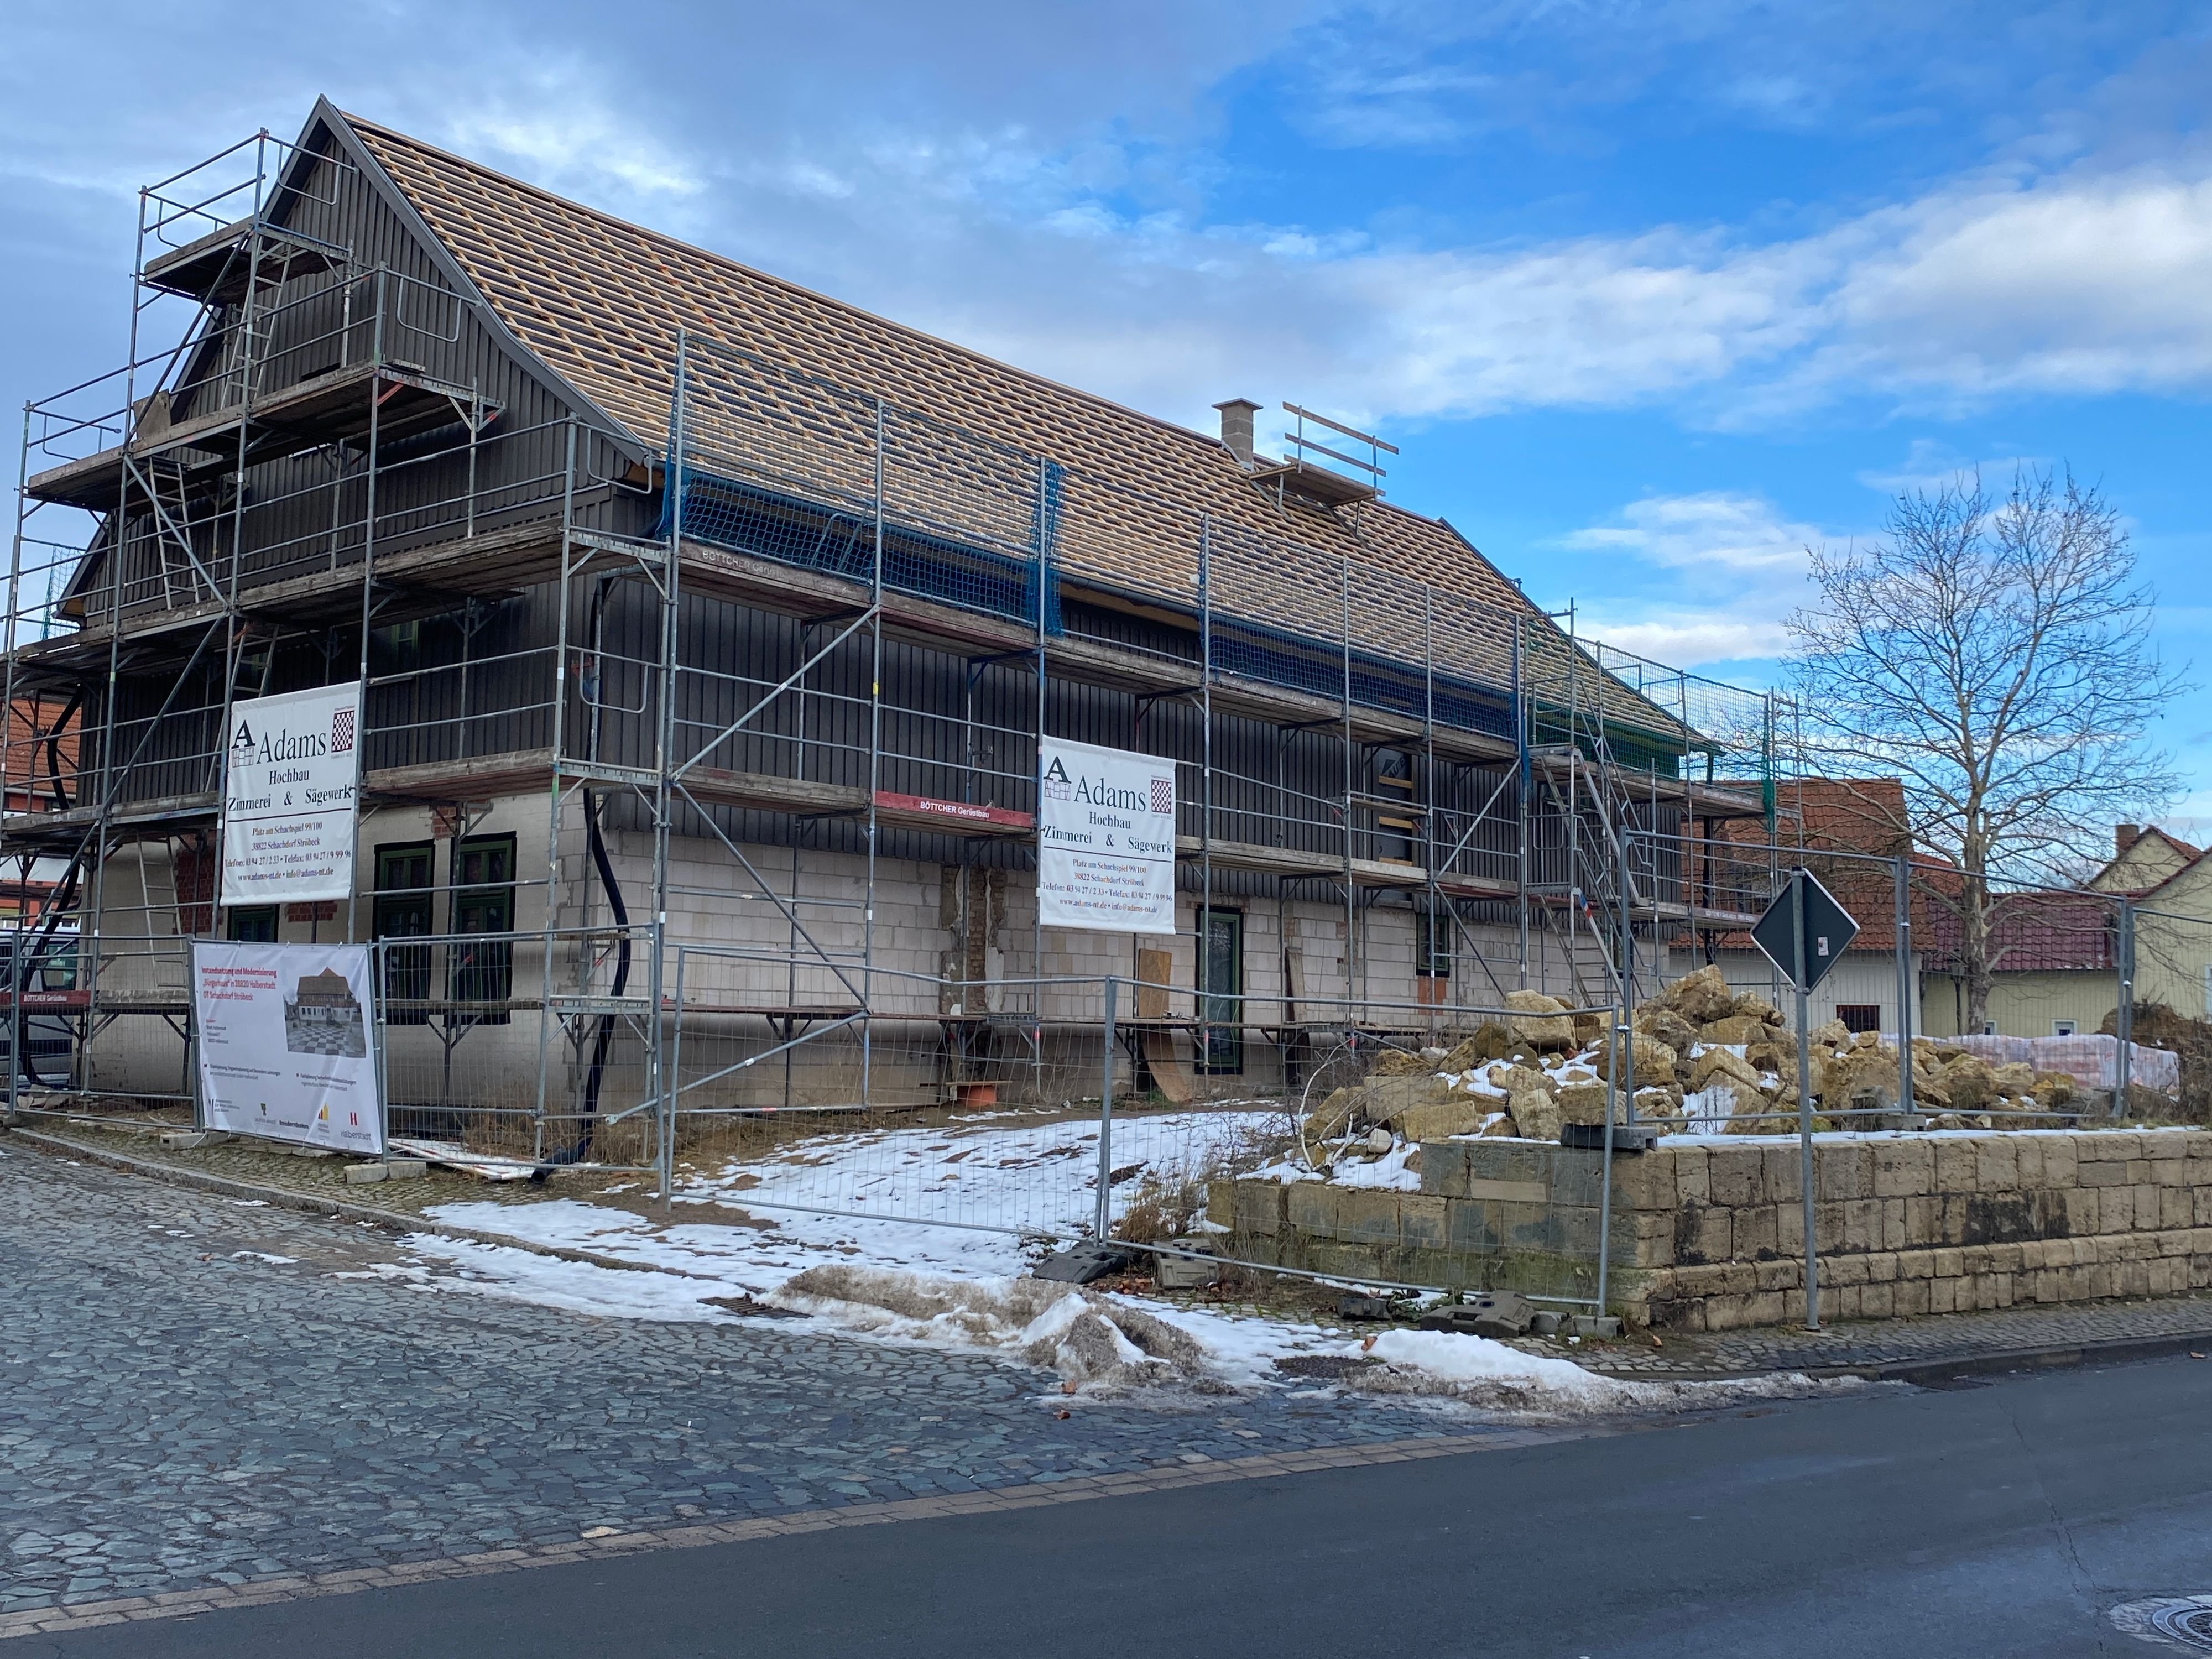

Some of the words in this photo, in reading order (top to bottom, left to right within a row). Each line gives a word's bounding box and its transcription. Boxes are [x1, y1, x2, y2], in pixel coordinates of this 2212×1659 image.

[257, 728, 326, 764] Adams
[269, 768, 309, 785] Hochbau
[228, 794, 271, 811] Zimmerei
[284, 791, 293, 806] &
[305, 784, 352, 806] Sägewerk
[1074, 775, 1146, 812] Adams
[920, 801, 957, 813] BÖTTCHER
[958, 807, 989, 818] Gerüstbau
[274, 823, 304, 834] Schachspiel
[305, 822, 322, 831] 99/100
[1089, 812, 1131, 830] Hochbau
[267, 839, 296, 849] Schachdorf
[298, 837, 320, 847] Ströbeck
[1044, 825, 1092, 844] Zimmerei
[1105, 834, 1114, 847] &
[1128, 836, 1172, 854] Sägewerk
[1073, 858, 1087, 867] Platz
[1098, 862, 1128, 873] Schachspiel
[1074, 872, 1090, 881] 38822
[1091, 874, 1121, 884] Schachdorf
[1121, 878, 1145, 886] Ströbeck
[1042, 882, 1065, 891] Telefon:
[1109, 889, 1130, 898] Telefax:
[340, 1130, 371, 1141] Halberstadt
